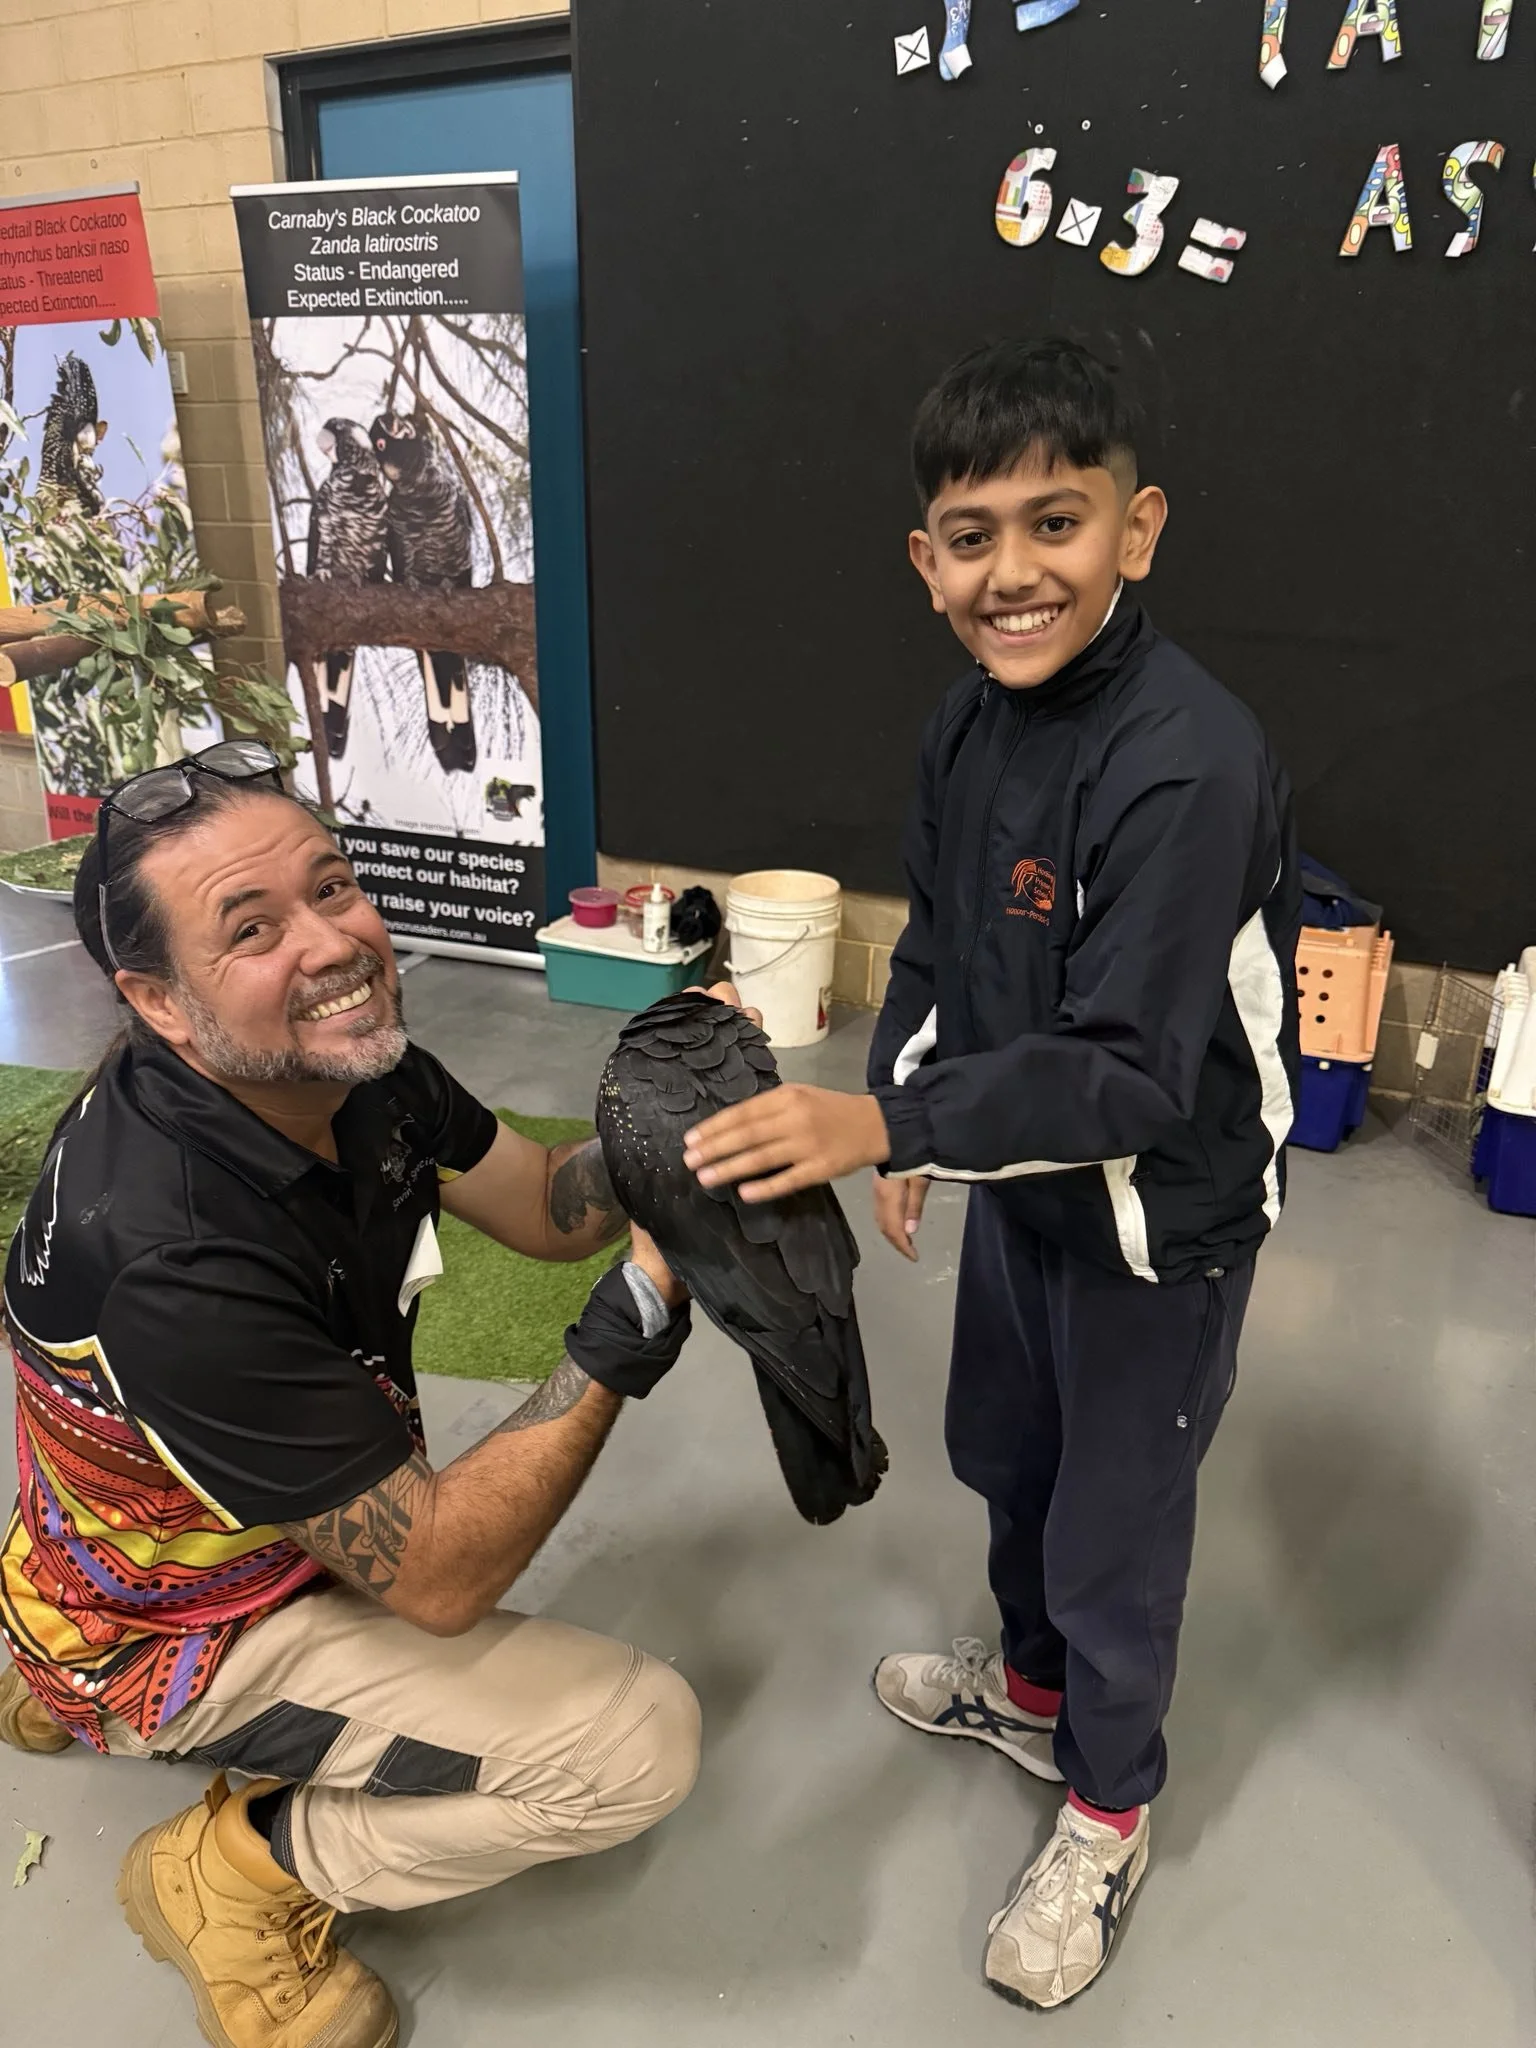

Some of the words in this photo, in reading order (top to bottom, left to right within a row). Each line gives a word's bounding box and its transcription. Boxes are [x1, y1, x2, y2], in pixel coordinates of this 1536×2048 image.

[0, 220, 32, 240] edtail
[35, 217, 67, 237] Black
[70, 212, 127, 232] Cockatoo
[268, 208, 347, 232] Carnaby's
[351, 205, 397, 227] Black
[400, 203, 481, 225] Cockatoo
[0, 245, 53, 268] rhynchus
[55, 239, 97, 260] banksii
[99, 239, 130, 256] naso
[309, 233, 361, 255] Zanda
[364, 231, 439, 253] latirostris
[0, 275, 26, 290] atus
[36, 264, 103, 286] Threatened
[293, 263, 345, 282] Status
[358, 257, 459, 284] Endangered
[0, 296, 39, 318] pected
[286, 287, 361, 312] Expected
[343, 836, 378, 856] you
[380, 841, 421, 860] save
[424, 847, 455, 864] our
[458, 852, 526, 874] species
[352, 861, 414, 882] protect
[415, 868, 447, 886] our
[448, 869, 520, 896] habitat?
[381, 892, 426, 914] raise
[428, 900, 471, 920] your
[473, 906, 536, 929] voice?
